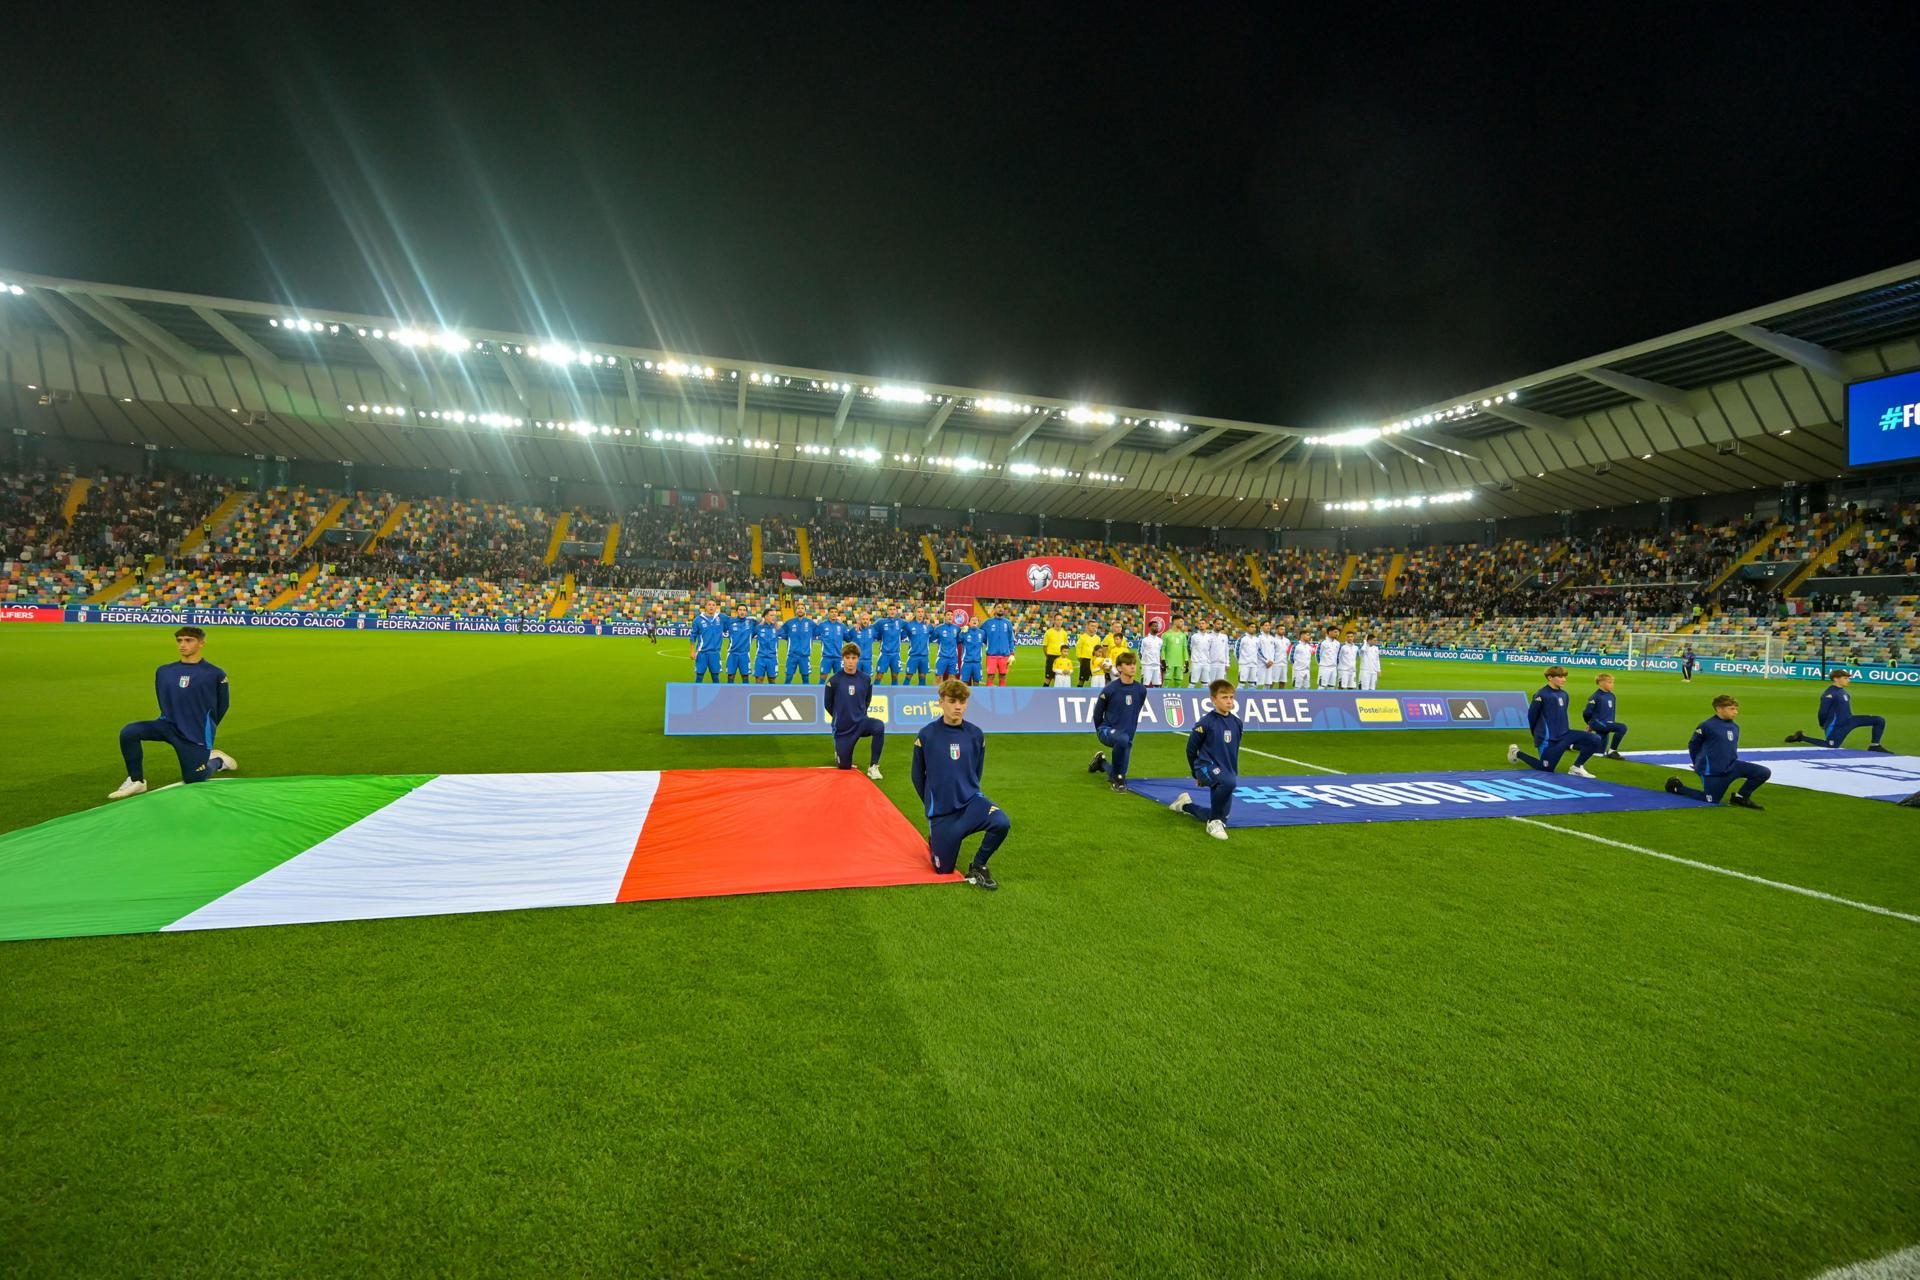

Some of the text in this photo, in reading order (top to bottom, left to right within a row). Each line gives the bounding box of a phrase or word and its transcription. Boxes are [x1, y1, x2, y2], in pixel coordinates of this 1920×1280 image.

[1057, 572, 1096, 581] EUROPEAN
[1052, 580, 1101, 590] QUALIFIERS
[100, 613, 188, 623] FEDERAZIONE
[193, 614, 246, 625] ITALIANA
[251, 616, 299, 627] GIUOCO
[303, 618, 345, 628] CALCIO
[376, 620, 450, 630] FEDERAZIONE
[455, 621, 500, 631] ITALIANA
[549, 624, 585, 634] CALCIO
[612, 627, 676, 636] FEDERAIONE
[1433, 651, 1457, 660] GIUOCO
[1459, 653, 1483, 661] CALCIO
[1505, 654, 1678, 669] FEDERAZIONE ITALIANA GIUOCO CALCIO
[1869, 669, 1920, 682] GIUOC
[903, 701, 927, 715] eni
[1419, 703, 1443, 716] TIM
[1231, 778, 1614, 809] #FOOTBALL
